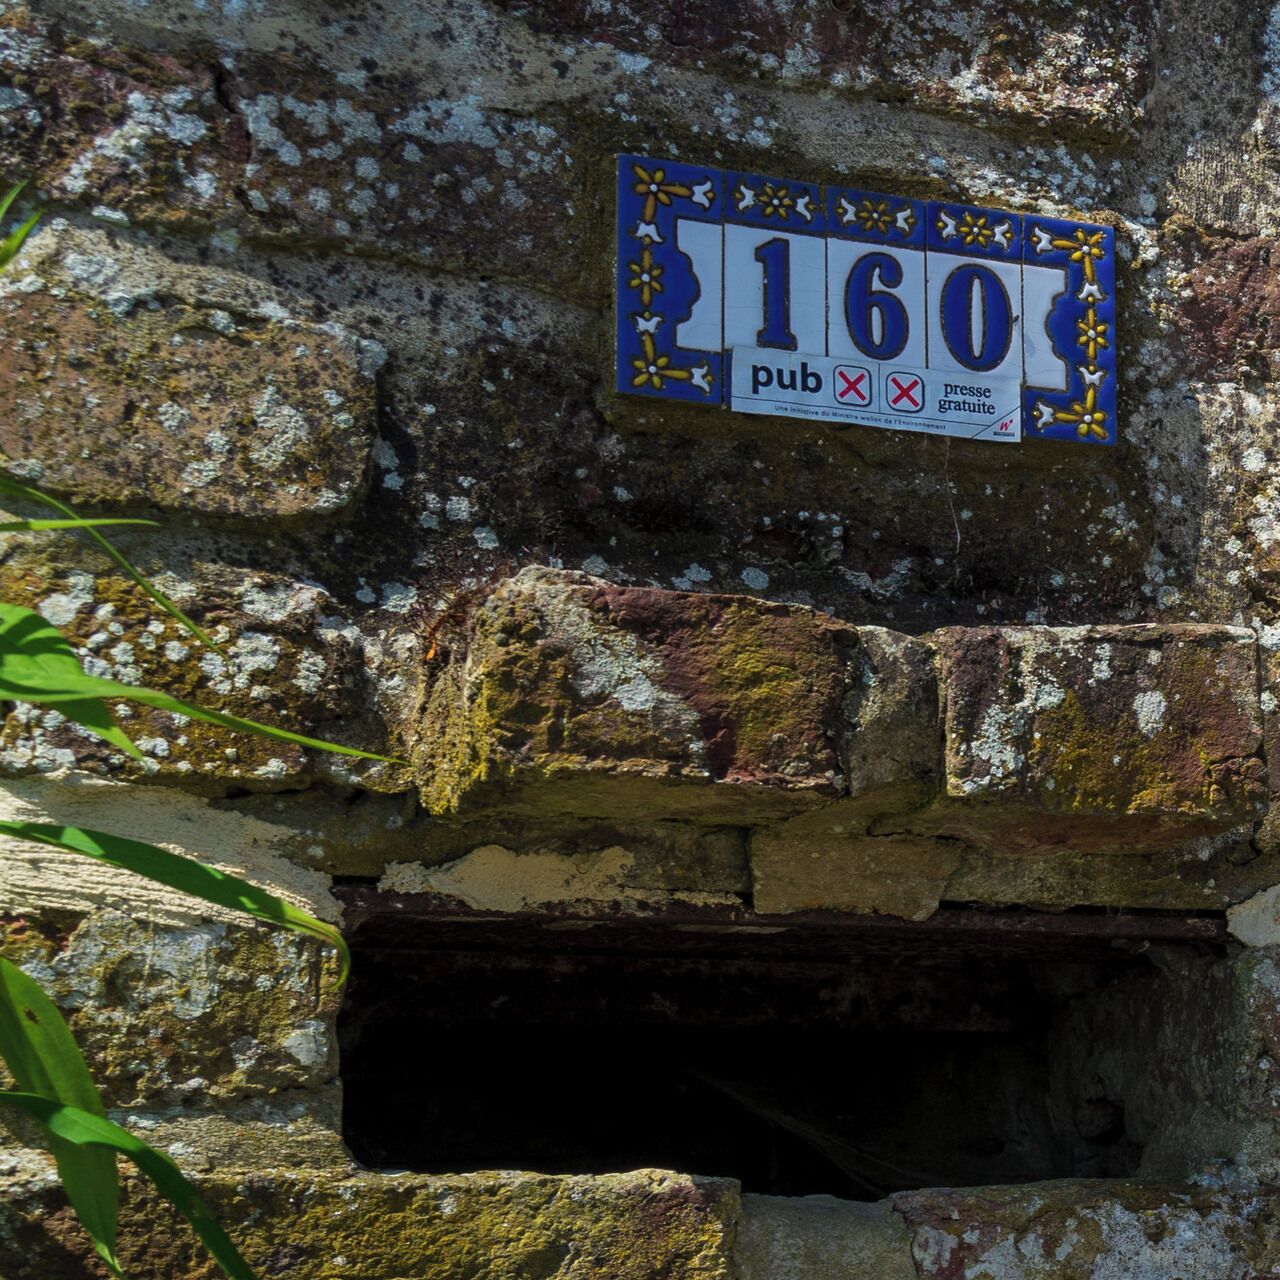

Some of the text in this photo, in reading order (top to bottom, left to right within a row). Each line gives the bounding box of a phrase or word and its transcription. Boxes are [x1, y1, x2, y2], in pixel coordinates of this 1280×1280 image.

[754, 237, 1013, 373] 160
[752, 362, 823, 395] pub
[944, 382, 992, 400] presse
[790, 406, 819, 416] initiative
[821, 409, 830, 417] du
[832, 411, 859, 420] Ministre
[884, 417, 892, 425] de
[938, 398, 996, 415] gratuite
